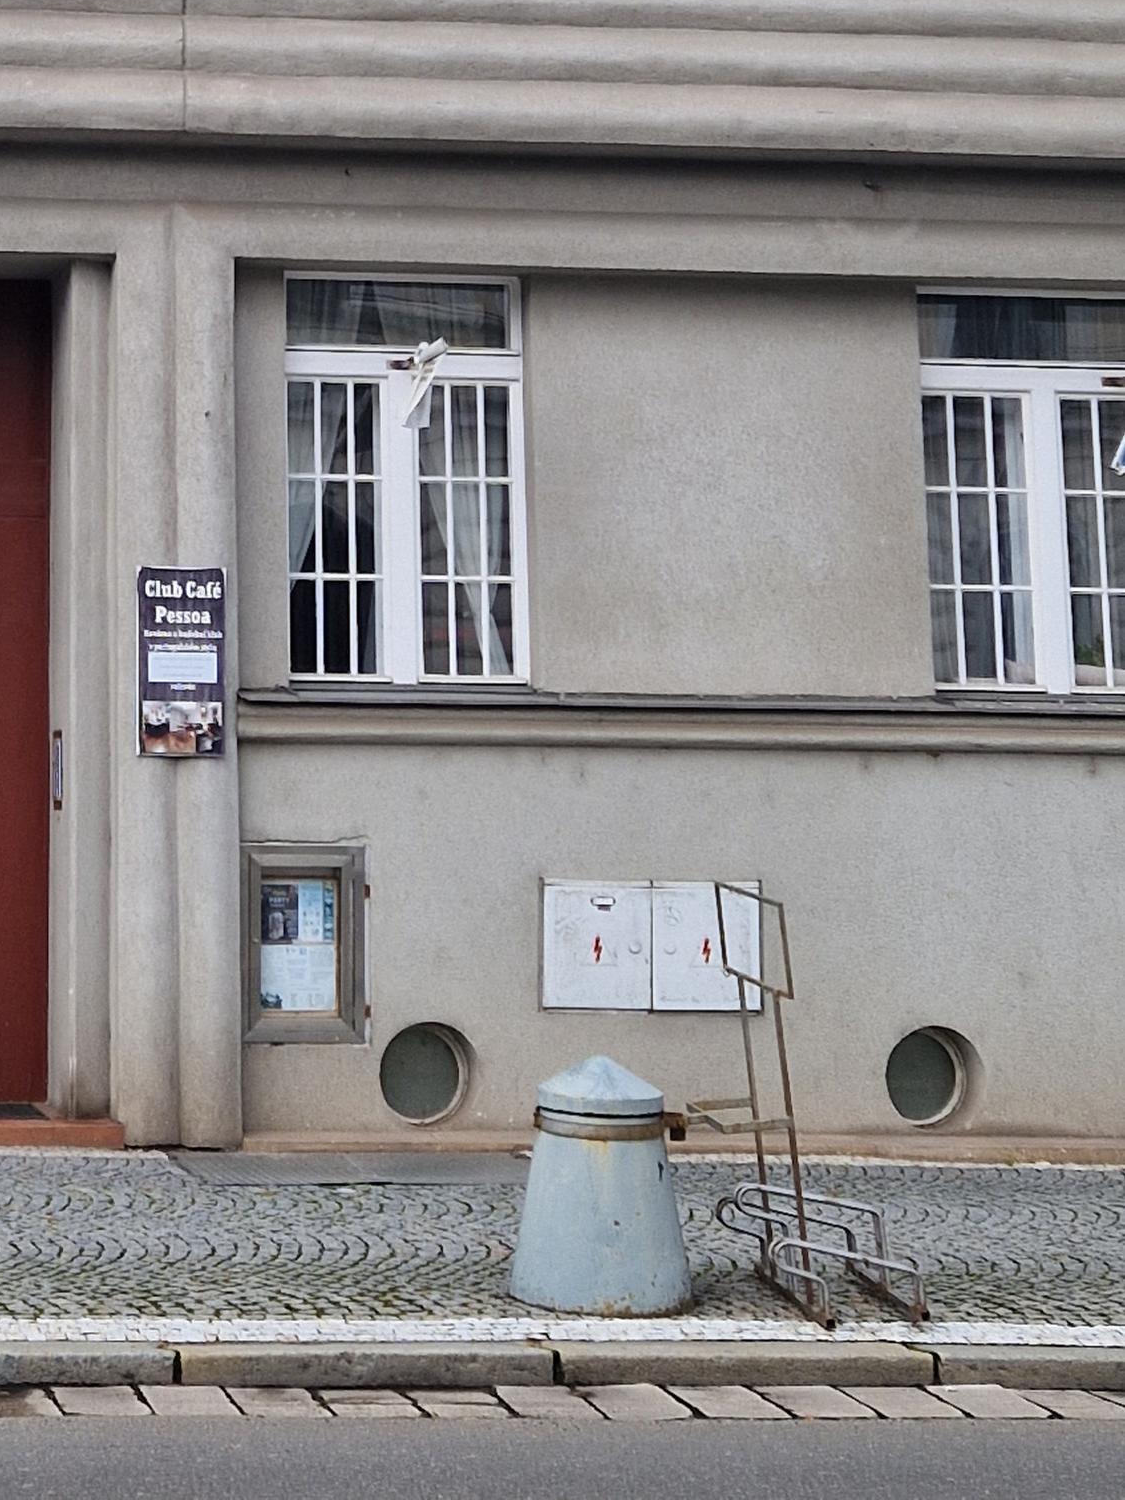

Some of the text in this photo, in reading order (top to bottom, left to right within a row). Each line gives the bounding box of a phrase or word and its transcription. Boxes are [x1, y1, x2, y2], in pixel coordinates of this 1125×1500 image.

[145, 580, 222, 599] Club Café
[154, 605, 212, 624] Pessoa
